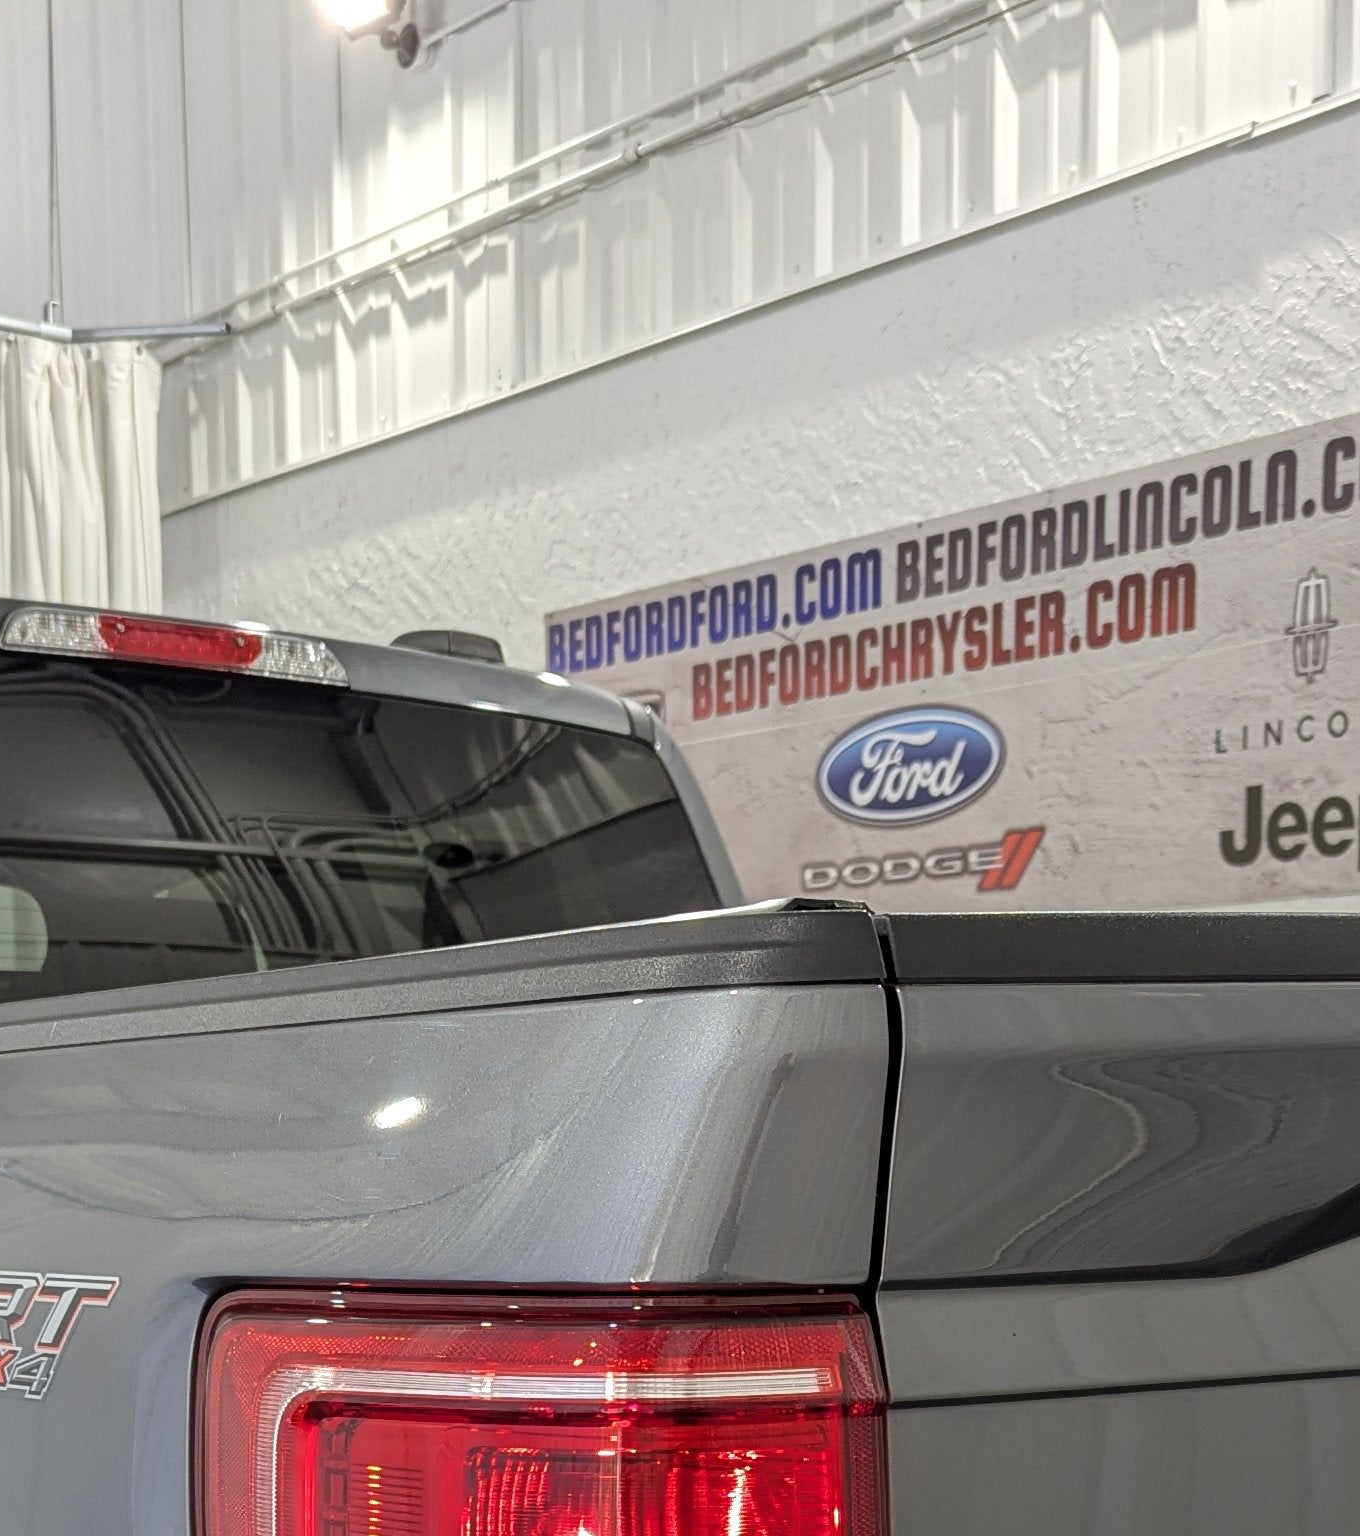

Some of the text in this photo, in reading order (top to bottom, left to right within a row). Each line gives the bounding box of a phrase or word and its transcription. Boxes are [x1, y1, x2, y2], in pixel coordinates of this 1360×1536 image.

[547, 548, 883, 674] BEDFORDFORD.COM
[692, 562, 1197, 722] BEDFORDCHRYSLER.COM
[848, 728, 969, 807] Ford
[802, 842, 1006, 892] DODGE
